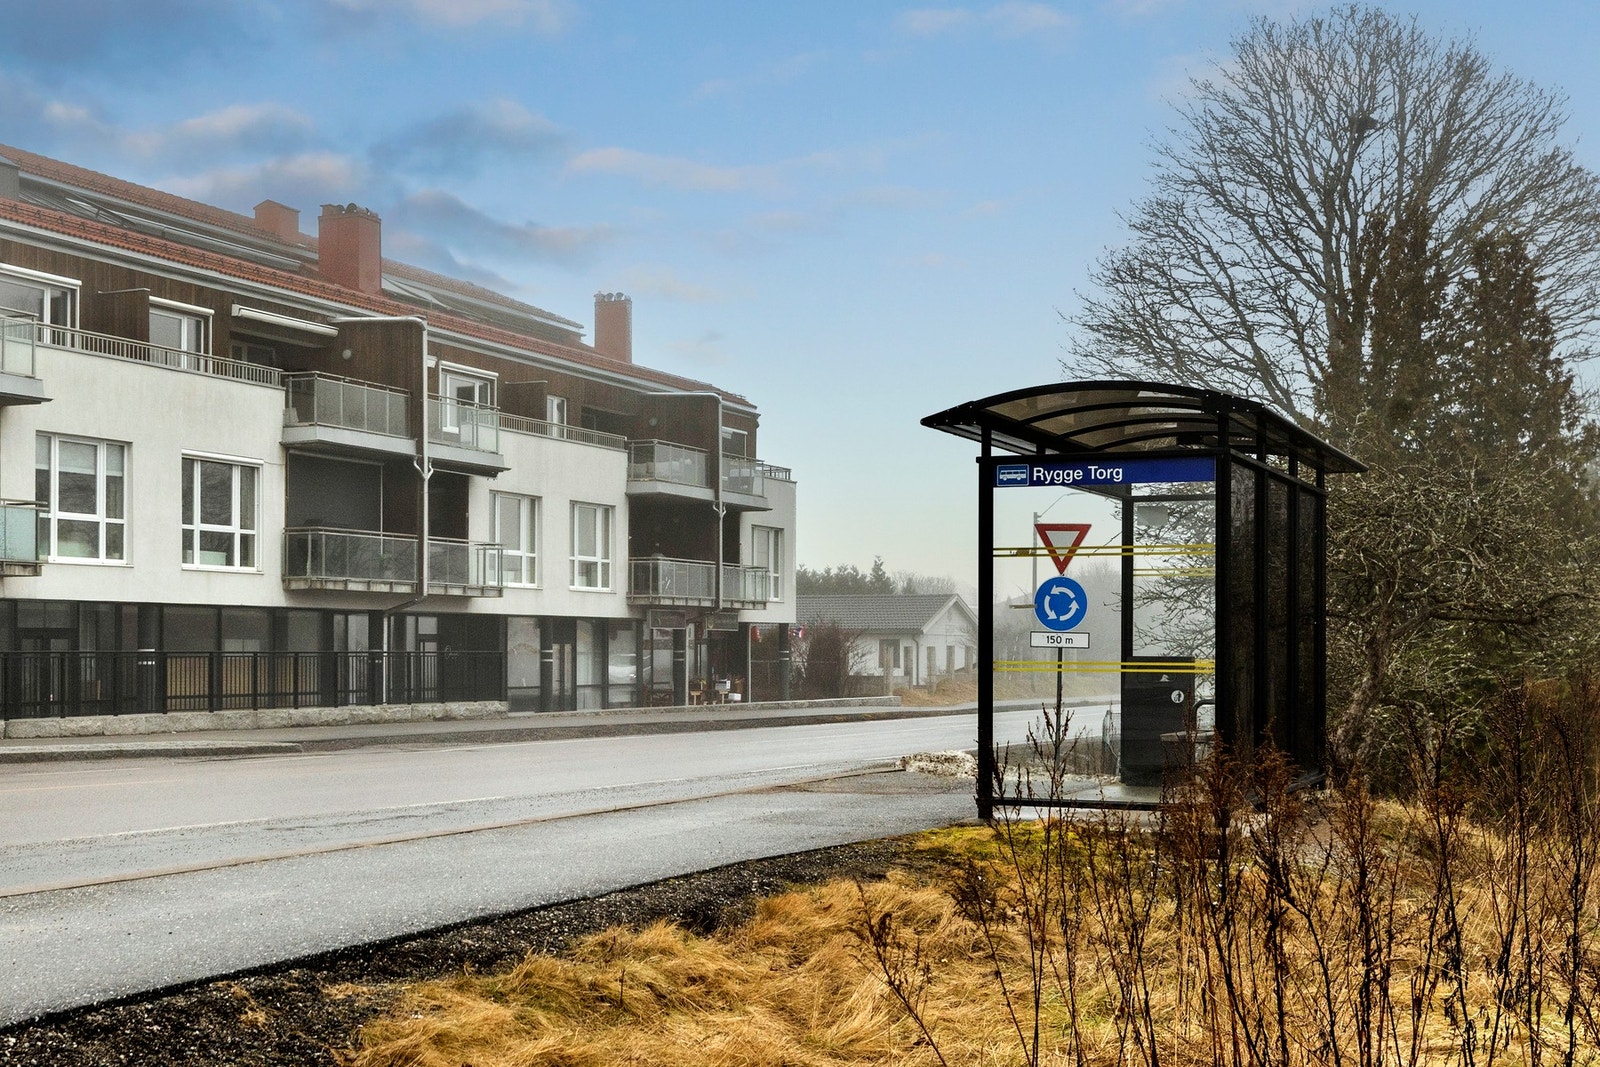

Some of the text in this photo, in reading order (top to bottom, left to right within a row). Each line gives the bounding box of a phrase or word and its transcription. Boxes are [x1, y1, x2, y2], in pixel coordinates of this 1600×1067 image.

[1033, 465, 1123, 484] Rygge Torg
[1046, 635, 1062, 644] 150
